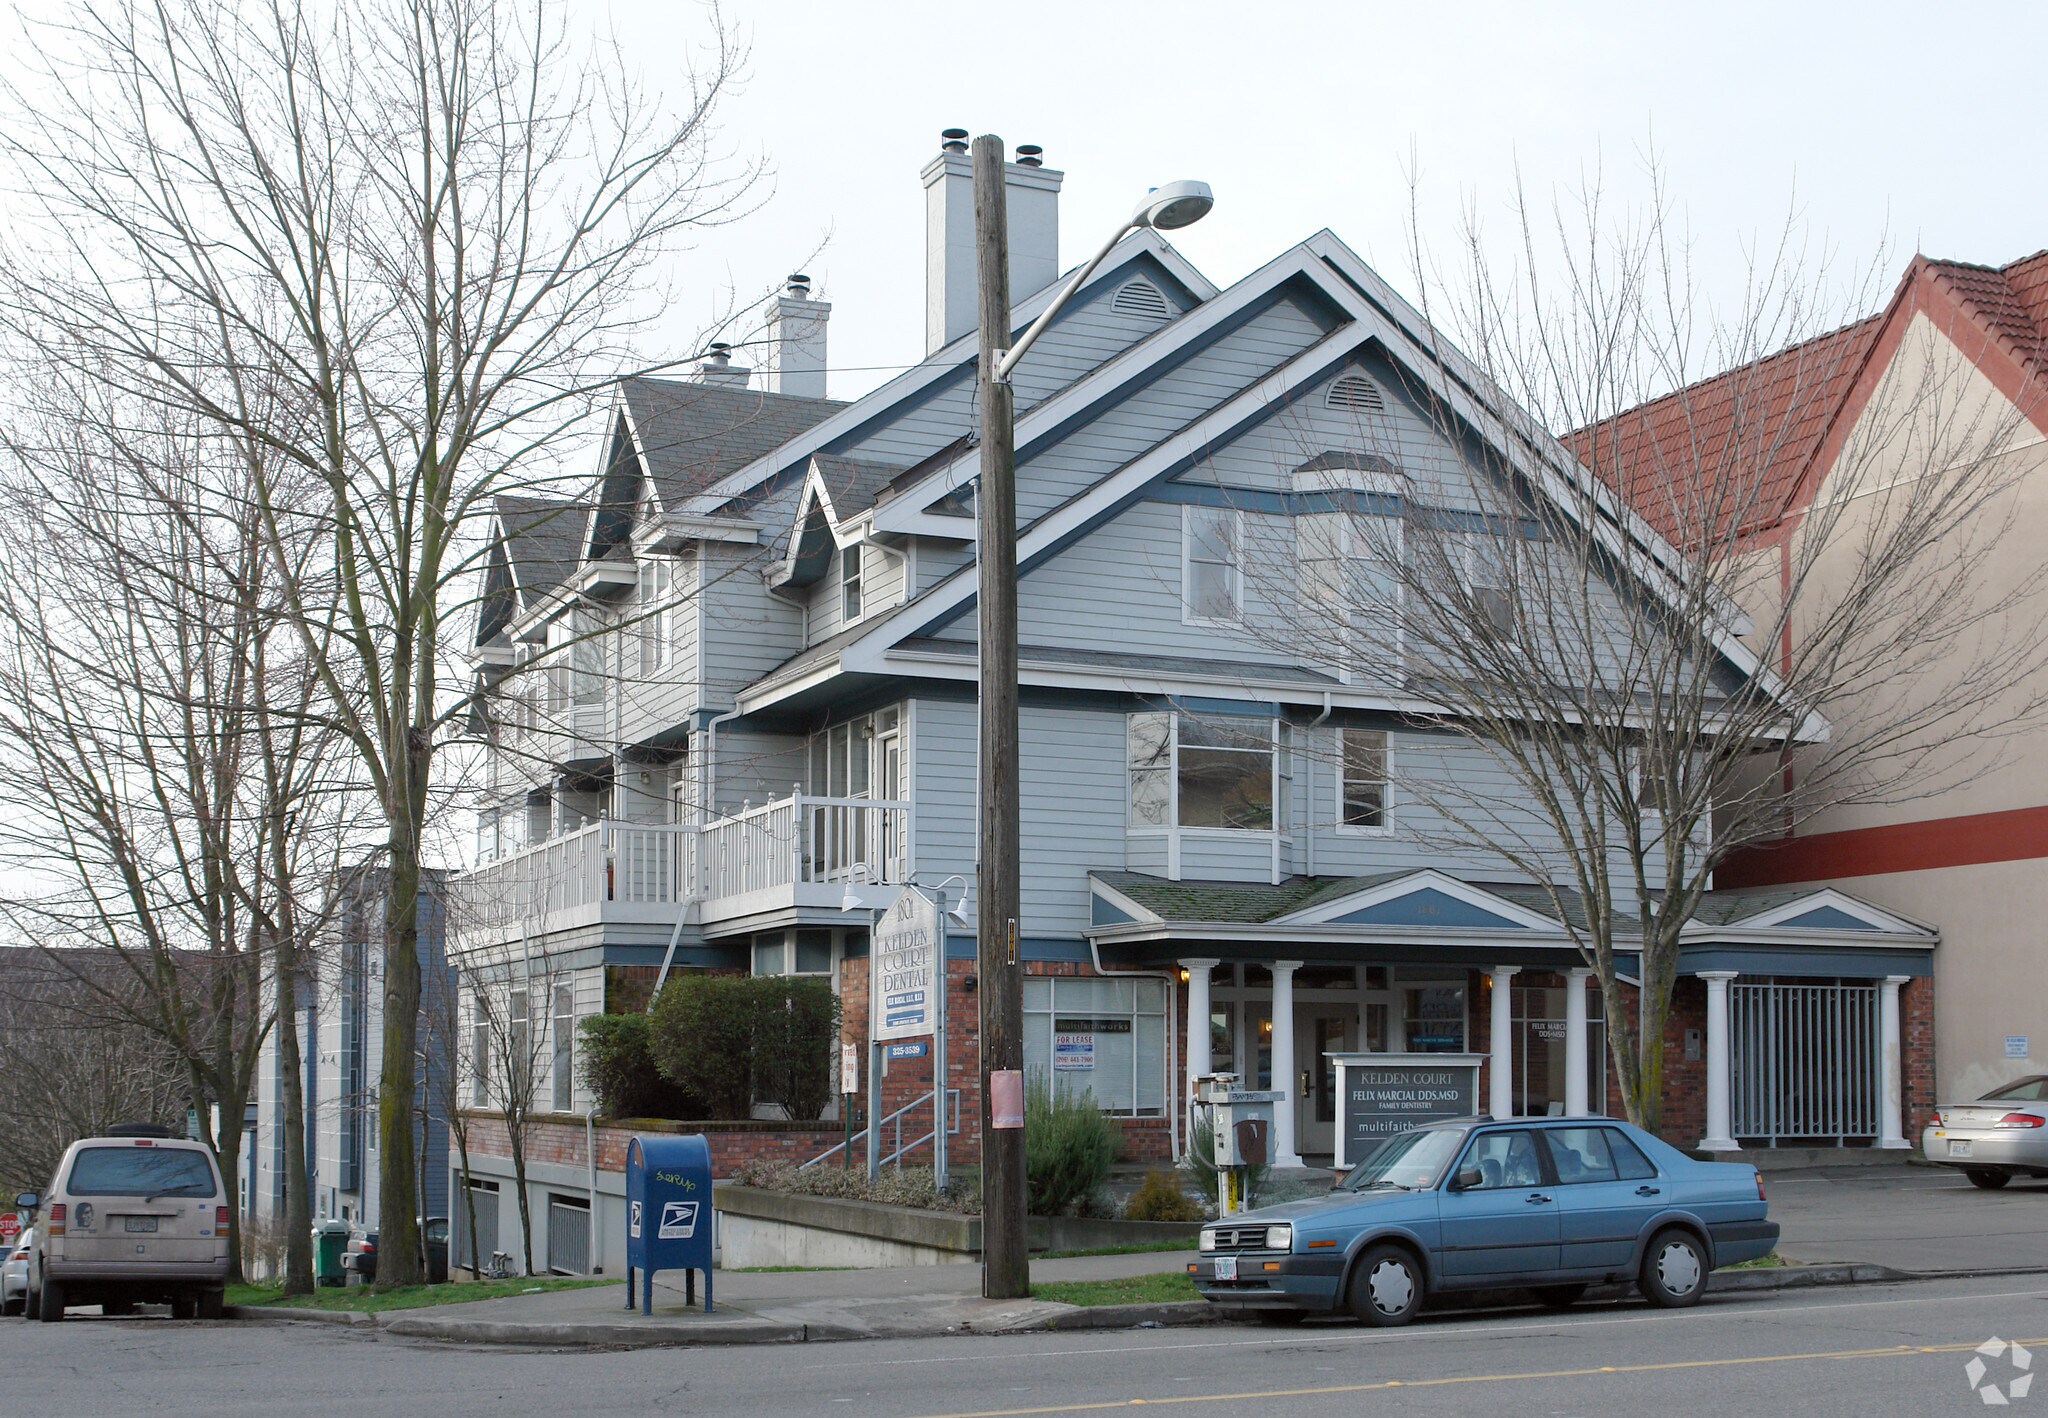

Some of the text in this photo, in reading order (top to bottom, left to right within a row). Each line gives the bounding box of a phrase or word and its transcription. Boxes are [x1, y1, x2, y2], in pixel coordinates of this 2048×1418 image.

[897, 898, 914, 922] 1801
[884, 927, 928, 953] KELDEN
[883, 947, 928, 972] COURT
[884, 968, 928, 992] DENTAL
[1361, 1073, 1454, 1084] KELDEN COURT
[1353, 1091, 1375, 1100] FELIX
[1377, 1091, 1417, 1100] MARCIAL
[1359, 1121, 1418, 1132] multifaith
[0, 1220, 19, 1229] STOP
